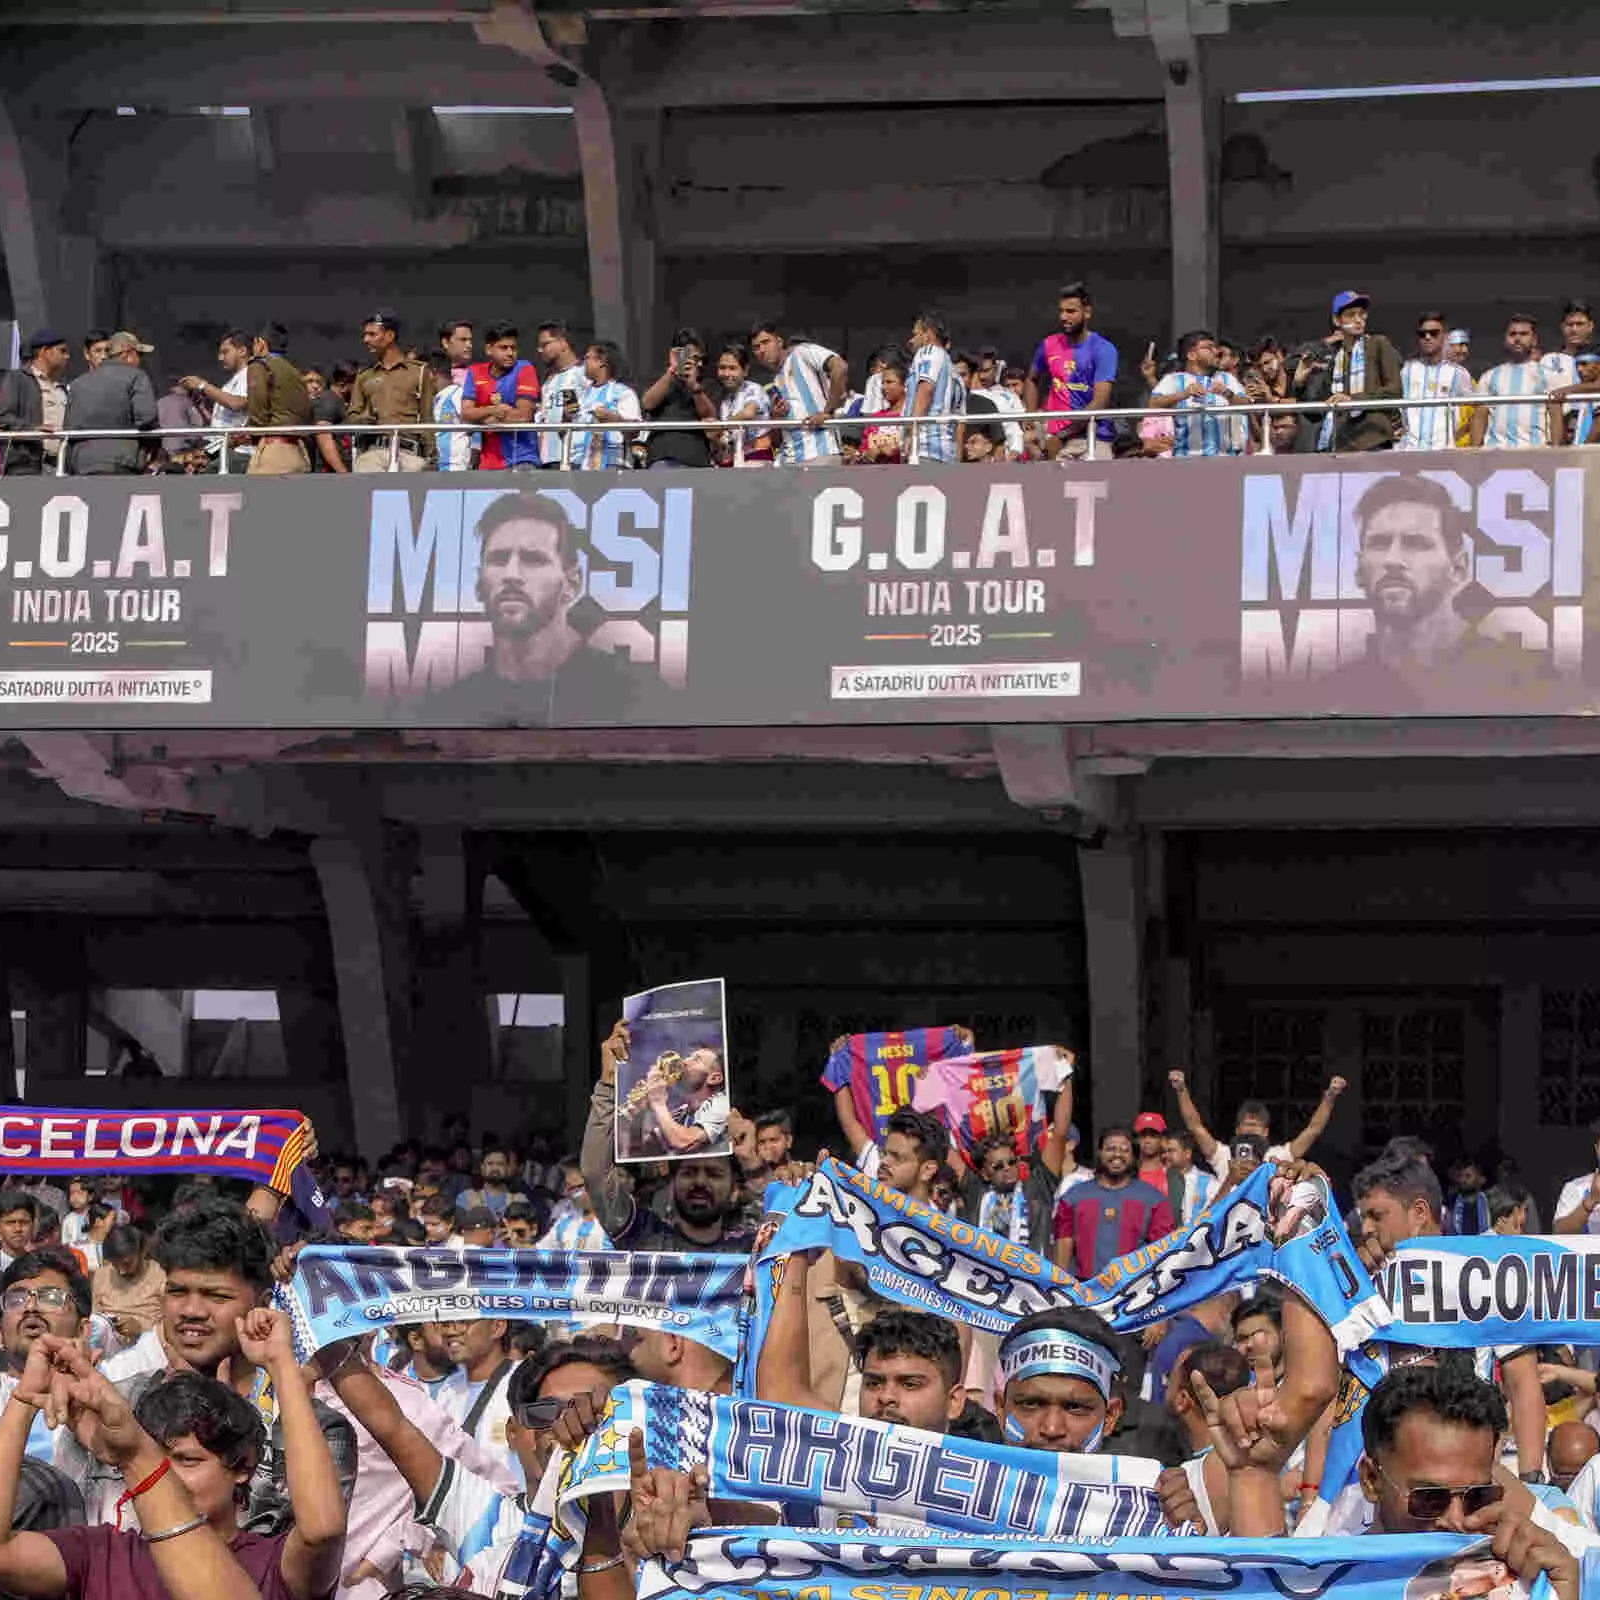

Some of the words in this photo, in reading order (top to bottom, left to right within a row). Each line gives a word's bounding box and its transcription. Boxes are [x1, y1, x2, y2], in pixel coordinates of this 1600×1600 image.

[11, 589, 92, 623] INDIA
[104, 589, 182, 622] TOUR
[867, 581, 952, 616] INDIA
[963, 579, 1045, 614] TOUR
[71, 632, 119, 653] 2025
[929, 625, 982, 647] 2025
[68, 681, 114, 697] DUTTA
[118, 680, 192, 697] INITIATIVE
[839, 677, 850, 692] A
[853, 675, 924, 693] SATADRU
[928, 674, 977, 692] DUTTA
[981, 672, 1058, 691] INITIATIVE
[828, 1155, 1043, 1276] CAMPEONES
[869, 1262, 943, 1307] CAMPEONES
[363, 1293, 527, 1323] CAMPEONES
[532, 1295, 582, 1312] DEL
[585, 1299, 692, 1327] MUNDO
